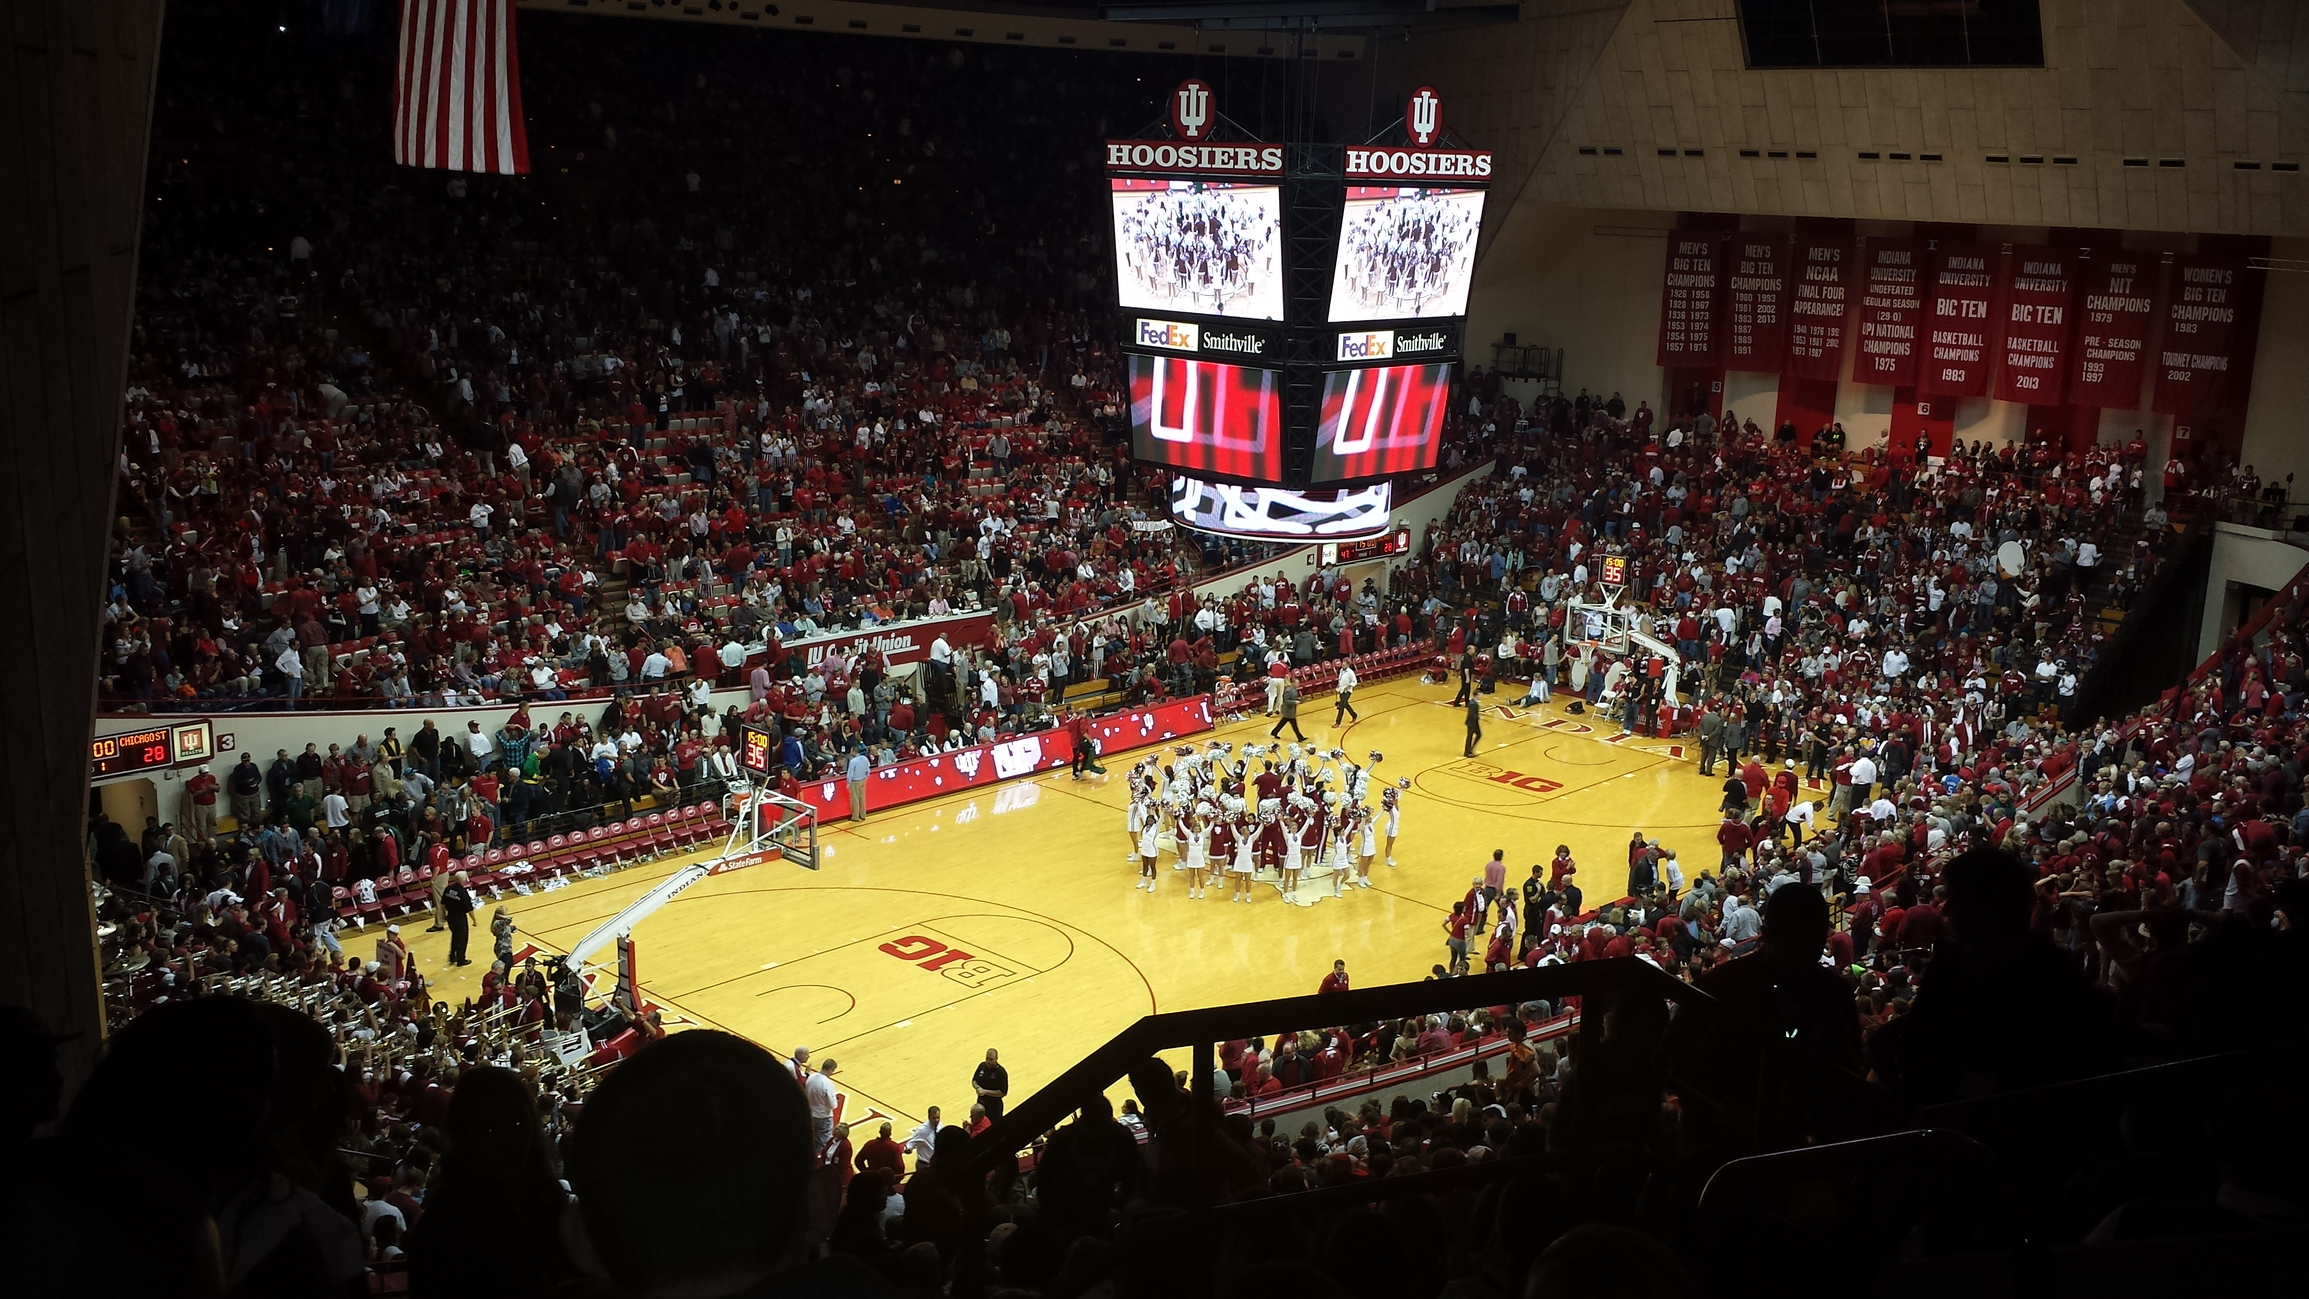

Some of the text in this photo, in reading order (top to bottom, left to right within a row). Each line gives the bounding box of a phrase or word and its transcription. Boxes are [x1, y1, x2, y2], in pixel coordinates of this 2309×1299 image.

[1107, 144, 1283, 170] HOOSIERS
[1346, 150, 1492, 176] HOOSIERS
[1679, 242, 1708, 255] MEN'S
[1745, 245, 1771, 258] MEN'S
[1809, 248, 1840, 261] MEN'S
[1878, 250, 1911, 265] INDIANA
[1948, 257, 1984, 270] INDIANA
[1674, 258, 1711, 271] BIG TEN
[1741, 261, 1773, 275] BIG TEN
[2023, 262, 2061, 275] INDIANA
[2111, 264, 2136, 274] MEN'S
[1667, 273, 1715, 287] CHAMPIONS
[1806, 266, 1838, 281] NCAA
[1870, 267, 1916, 282] UNIVERSITY
[1939, 272, 1991, 287] UNIVERSITY
[2184, 267, 2233, 284] WOMEN'S
[1731, 277, 1781, 291] CHAMPIONS
[1870, 284, 1914, 295] UNDEFEATED
[2015, 277, 2068, 292] UNIVERSITY
[2109, 278, 2133, 294] NIT
[1671, 289, 1710, 299] 1926 1958
[1736, 292, 1775, 302] 1980 1993
[1798, 284, 1844, 300] FINAL FOUR
[2184, 287, 2226, 303] BIG TEN
[1669, 300, 1709, 309] 1928 1967
[1735, 304, 1775, 313] 1981 2002
[1893, 299, 1920, 309] SEASON
[1936, 298, 1987, 318] BIG TEN
[2087, 295, 2151, 313] CHAMPIONS
[1669, 311, 1709, 320] 1936 1973
[1735, 314, 1775, 323] 1983 2013
[2011, 304, 2062, 324] BIG TEN
[2091, 312, 2112, 323] 1979
[2172, 305, 2234, 323] CHAMPIONS
[1668, 321, 1709, 330] 1953 1974
[1734, 325, 1752, 333] 1987
[1810, 326, 1824, 335] 1976
[1876, 324, 1914, 338] NATIONAL
[2175, 323, 2197, 333] 1983
[1140, 321, 1263, 354] FedEx Smithville
[1667, 332, 1708, 341] 1954 1975
[1734, 336, 1752, 344] 1989
[1933, 331, 1983, 346] BASKETBALL
[2085, 336, 2100, 346] PRE
[2108, 338, 2141, 349] SEASON
[1342, 334, 1445, 357] FedEx Smithville
[1666, 343, 1707, 351] 1957 1976
[1734, 346, 1751, 354] 1991
[1864, 340, 1910, 355] CHAMPIONS
[2007, 337, 2059, 353] BASKETBALL
[1934, 347, 1979, 361] CHAMPIONS
[2086, 349, 2135, 361] CHAMPIONS
[1875, 357, 1895, 371] 1975
[2008, 353, 2054, 369] CHAMPIONS
[2083, 362, 2104, 372] 1993
[2162, 352, 2228, 371] TOURNEY CHAMPIONS
[1942, 369, 1965, 382] 1983
[2082, 372, 2103, 383] 1997
[2168, 370, 2191, 381] 2002
[1714, 382, 1720, 391] 5
[2016, 376, 2039, 389] 2013
[1922, 404, 1928, 413] 6
[2180, 428, 2189, 438] 7
[1384, 542, 1393, 552] 28
[1308, 555, 1314, 564] 4
[1341, 550, 1350, 558] 47
[1606, 558, 1624, 567] 15:00
[1605, 567, 1621, 582] 35
[808, 646, 824, 664] IU
[873, 632, 912, 652] Union
[222, 735, 234, 749] 3
[748, 731, 768, 748] 15:00
[144, 746, 164, 762] 28
[748, 744, 764, 768] 35
